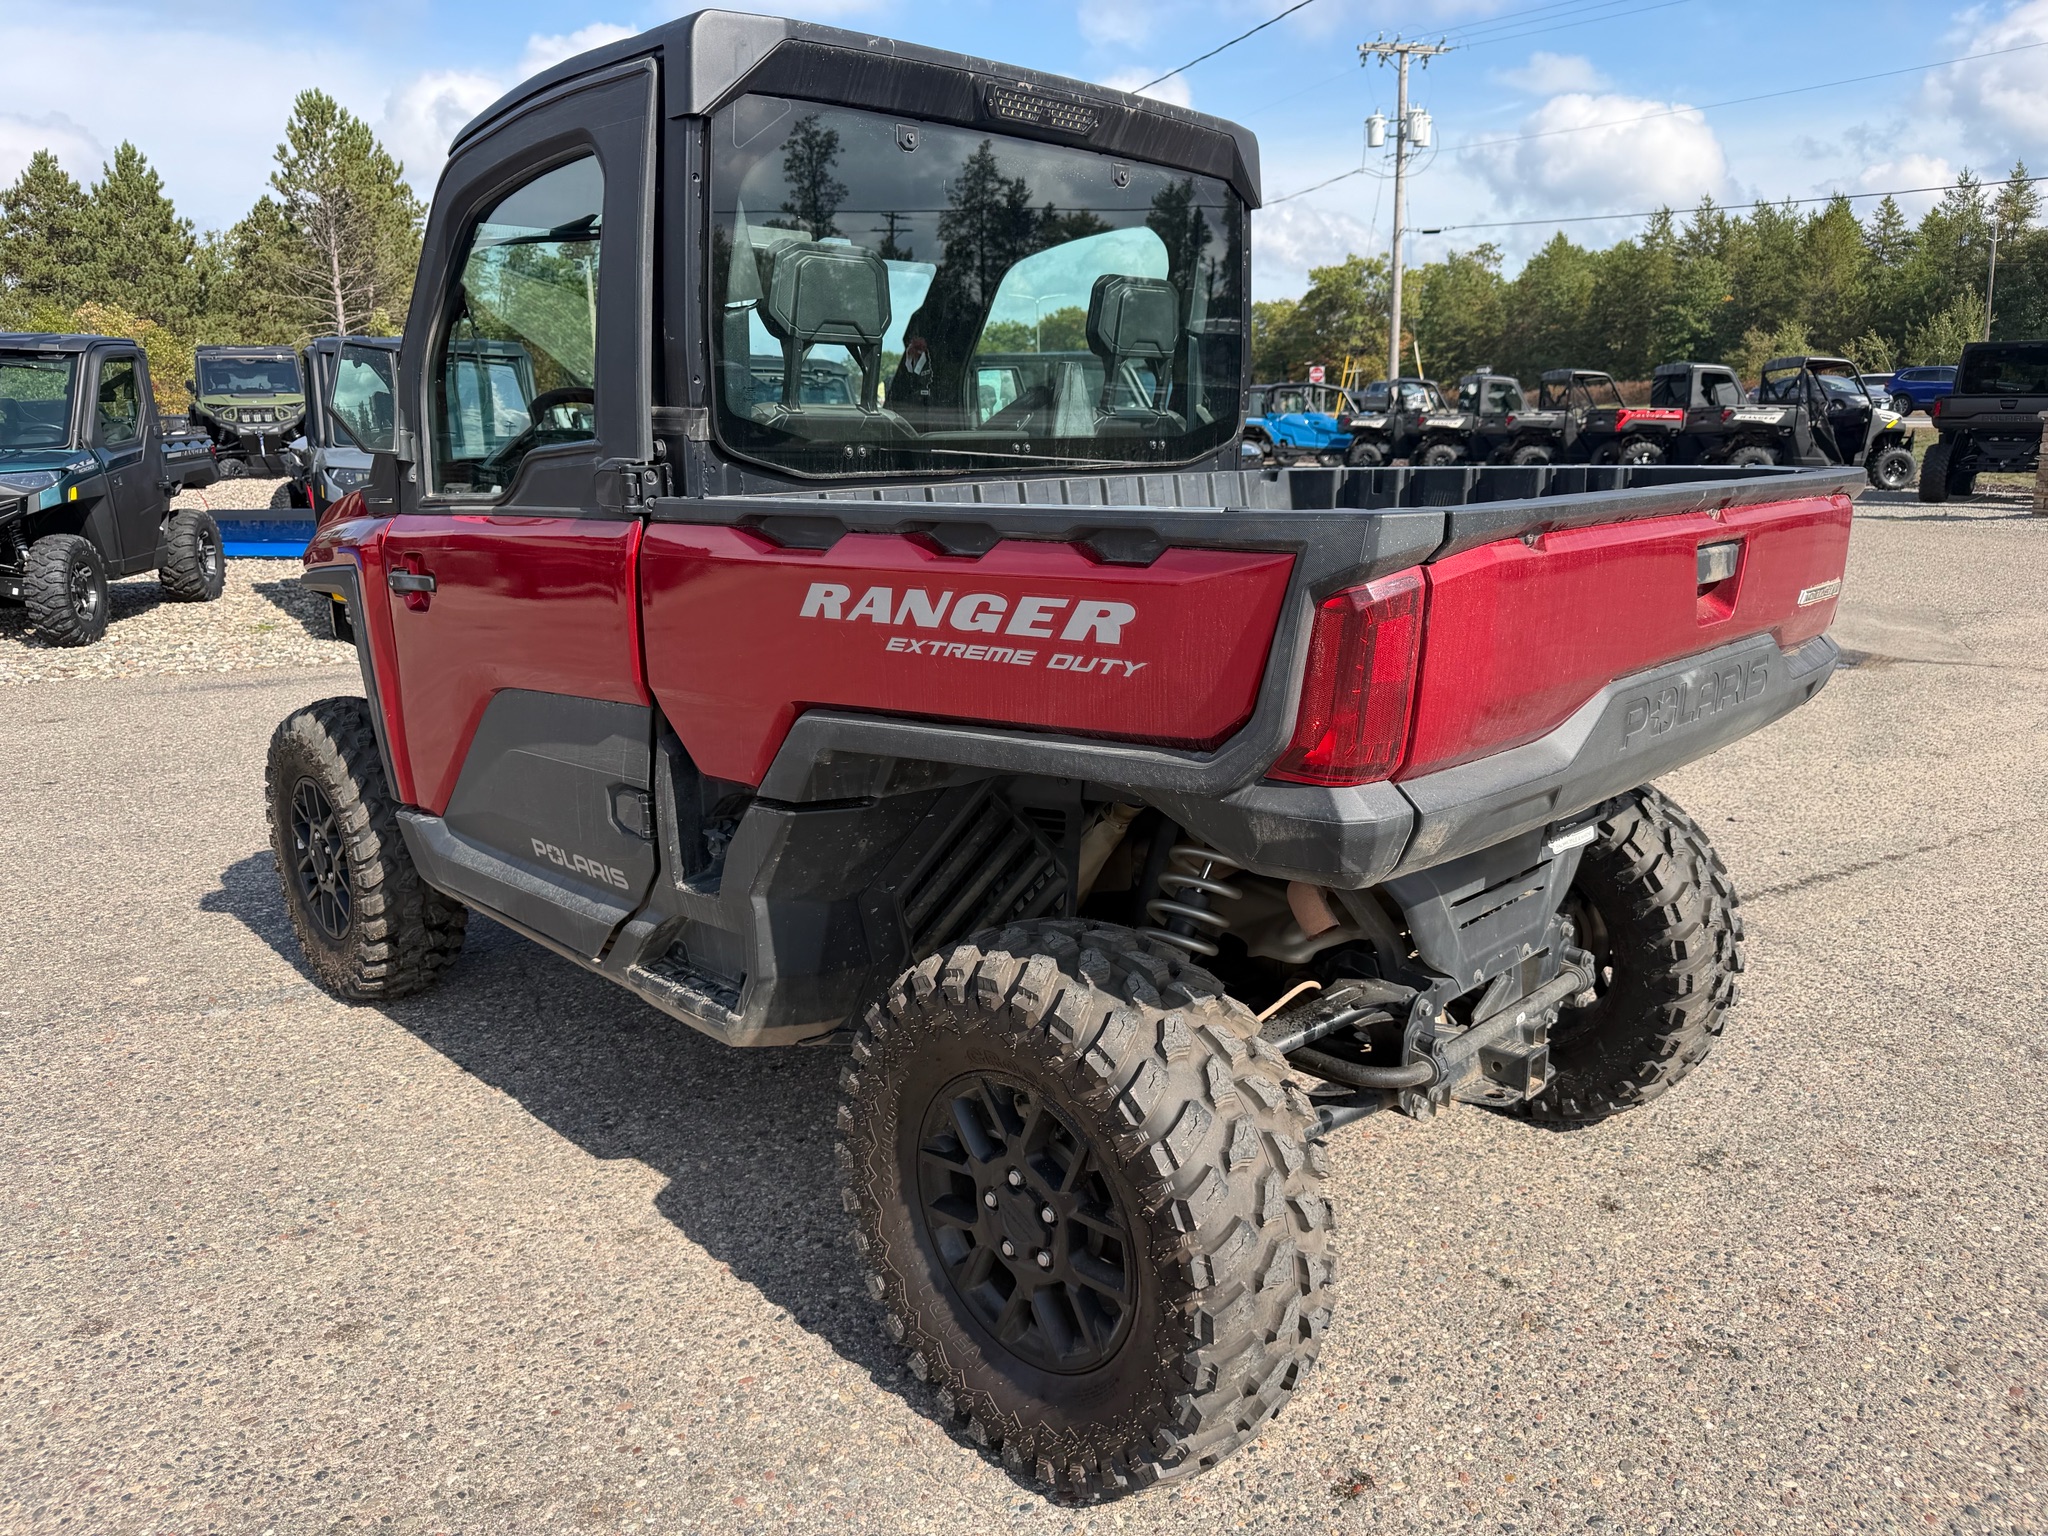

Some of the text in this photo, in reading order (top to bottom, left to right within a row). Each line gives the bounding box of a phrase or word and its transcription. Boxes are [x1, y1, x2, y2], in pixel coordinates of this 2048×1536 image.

[799, 582, 1136, 645] RANGER
[885, 637, 1148, 678] EXTREME DUTY
[1618, 653, 1770, 752] POLARIS
[530, 837, 630, 891] POLARIS
